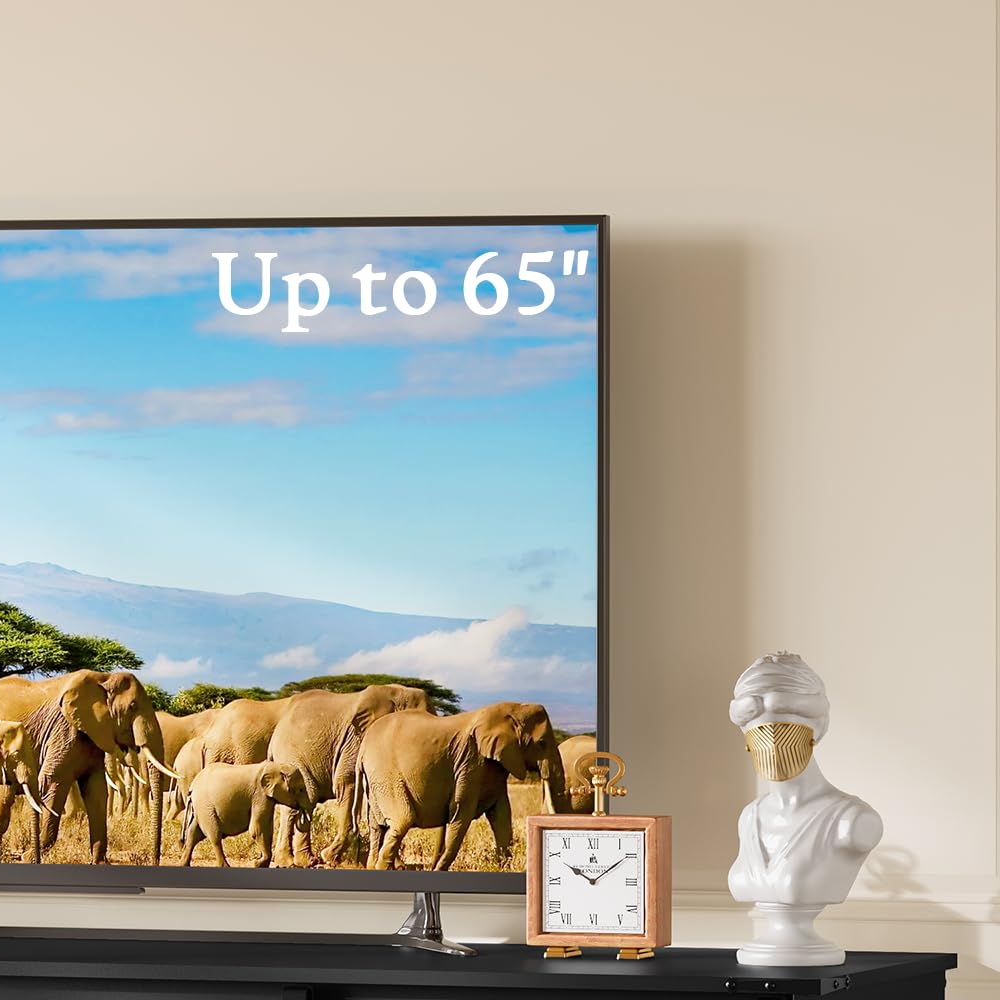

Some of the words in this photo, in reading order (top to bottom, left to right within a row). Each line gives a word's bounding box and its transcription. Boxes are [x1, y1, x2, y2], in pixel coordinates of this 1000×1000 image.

[562, 837, 571, 849] XI
[588, 838, 599, 850] XII
[549, 876, 561, 885] IX
[625, 877, 638, 887] III
[549, 900, 561, 914] VIII
[561, 912, 572, 925] VII
[589, 913, 598, 925] VI
